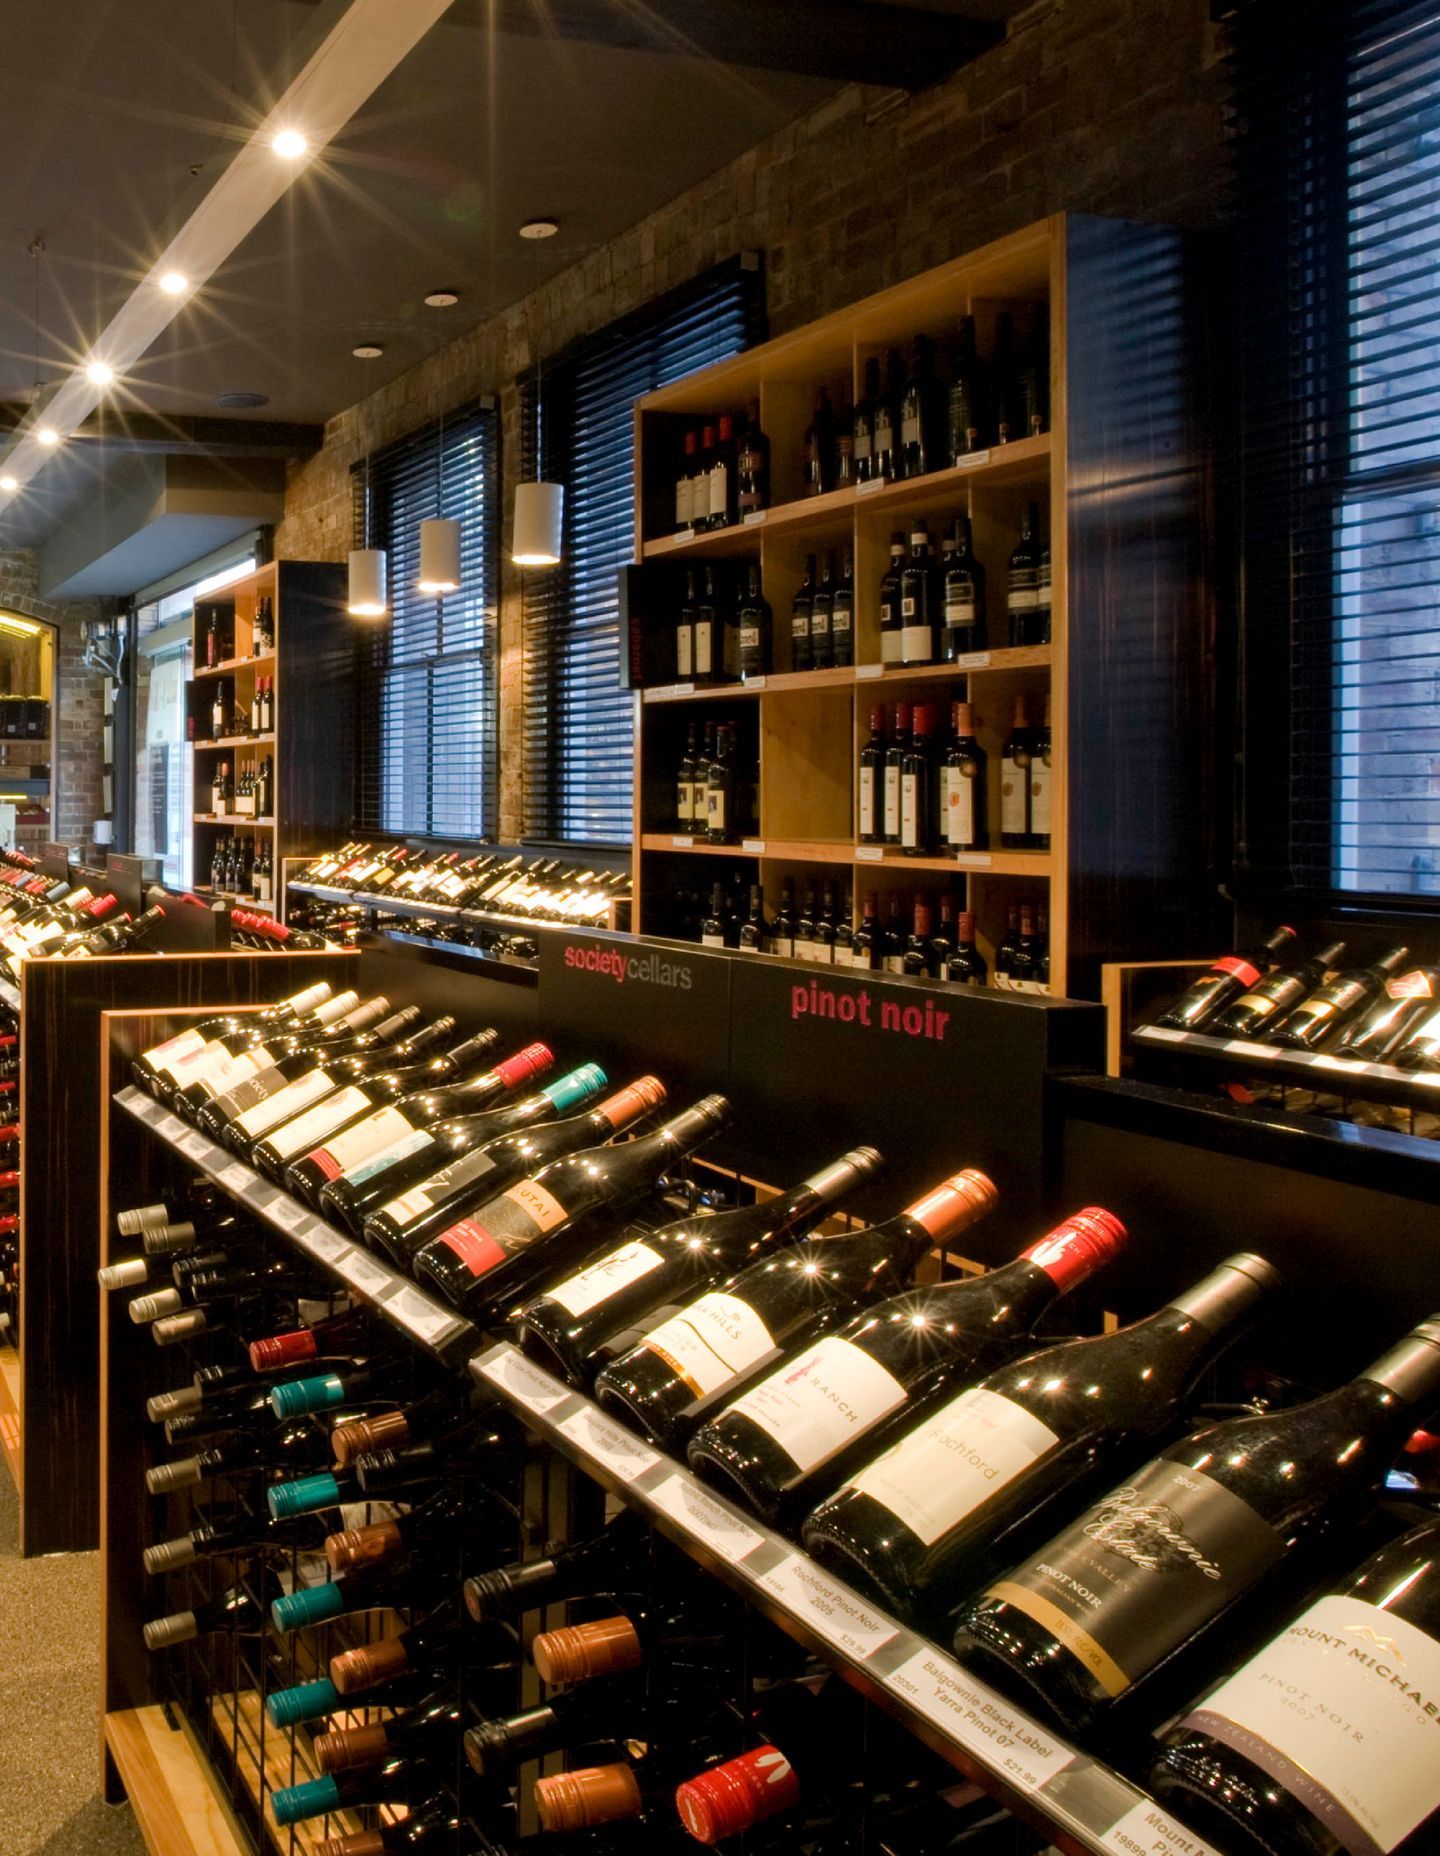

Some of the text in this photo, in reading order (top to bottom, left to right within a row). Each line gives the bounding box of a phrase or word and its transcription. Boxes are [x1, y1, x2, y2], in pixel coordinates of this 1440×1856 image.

[791, 980, 951, 1041] pinot noir
[711, 1311, 742, 1341] HILLS
[810, 1376, 859, 1423] RANCH
[928, 1427, 999, 1480] Rochford
[1172, 1475, 1202, 1492] 2007
[791, 1565, 881, 1633] Rochford Pinot Noir
[810, 1596, 835, 1617] 2005
[1035, 1562, 1103, 1609] PINOT NOIR
[1258, 1672, 1365, 1745] PINOT NOIR
[1280, 1695, 1316, 1722] 2007
[1348, 1647, 1440, 1726] MICHAE
[933, 1686, 1017, 1750] Yarra Pinot 07
[980, 1703, 1018, 1734] Black
[1014, 1728, 1055, 1759] Label
[1002, 1758, 1039, 1786] $21.99
[1197, 1713, 1336, 1814] NEW ZEALAND WINE
[1143, 1811, 1195, 1854] Mount
